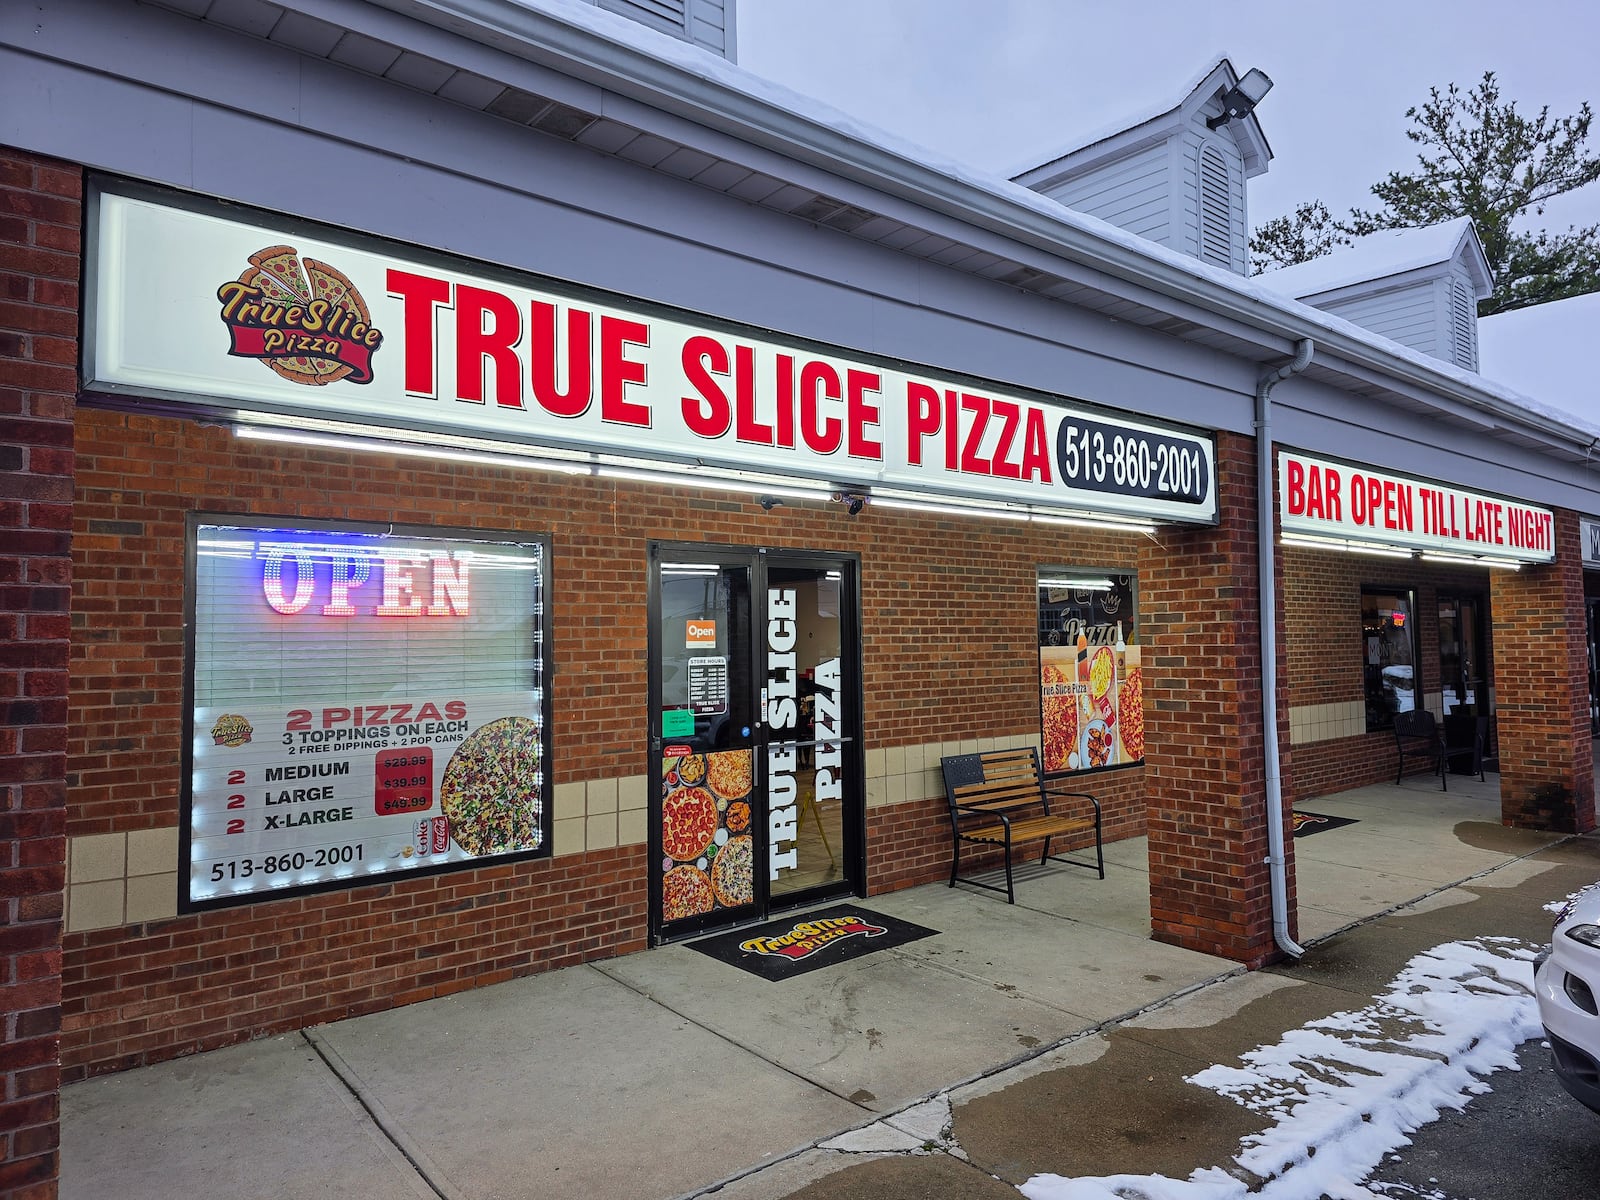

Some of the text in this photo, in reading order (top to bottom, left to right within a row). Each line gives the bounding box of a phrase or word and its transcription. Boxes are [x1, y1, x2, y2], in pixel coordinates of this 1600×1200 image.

[263, 329, 340, 356] Pizza
[386, 268, 1053, 486] TRUE SLICE PIZZA
[1064, 426, 1201, 497] 513-860-2001
[1288, 459, 1551, 552] BAR OPEN TILL LATE NIGHT
[263, 546, 474, 617] OPEN
[688, 625, 714, 638] Open
[1056, 684, 1071, 695] Slice
[1072, 683, 1087, 694] Pizza
[282, 721, 469, 745] 3 TOPPINGS ON EACH
[286, 701, 467, 731] 2 PIZZAS
[815, 657, 843, 802] PIZZA
[288, 747, 296, 755] 2
[300, 744, 330, 754] FREE
[334, 740, 389, 751] DIPPINGS
[401, 738, 408, 746] 2
[411, 736, 432, 745] POP
[435, 733, 464, 744] CANS
[767, 588, 798, 881] TRUE SLICE
[227, 756, 426, 785] 2 MEDIUM $29.99
[226, 776, 426, 810] 2 LARGE $39.99
[226, 797, 426, 834] 2 X-LARGE $49.99
[416, 820, 428, 855] Coke
[211, 844, 363, 882] 513-860-2001
[796, 929, 848, 951] Pizza
